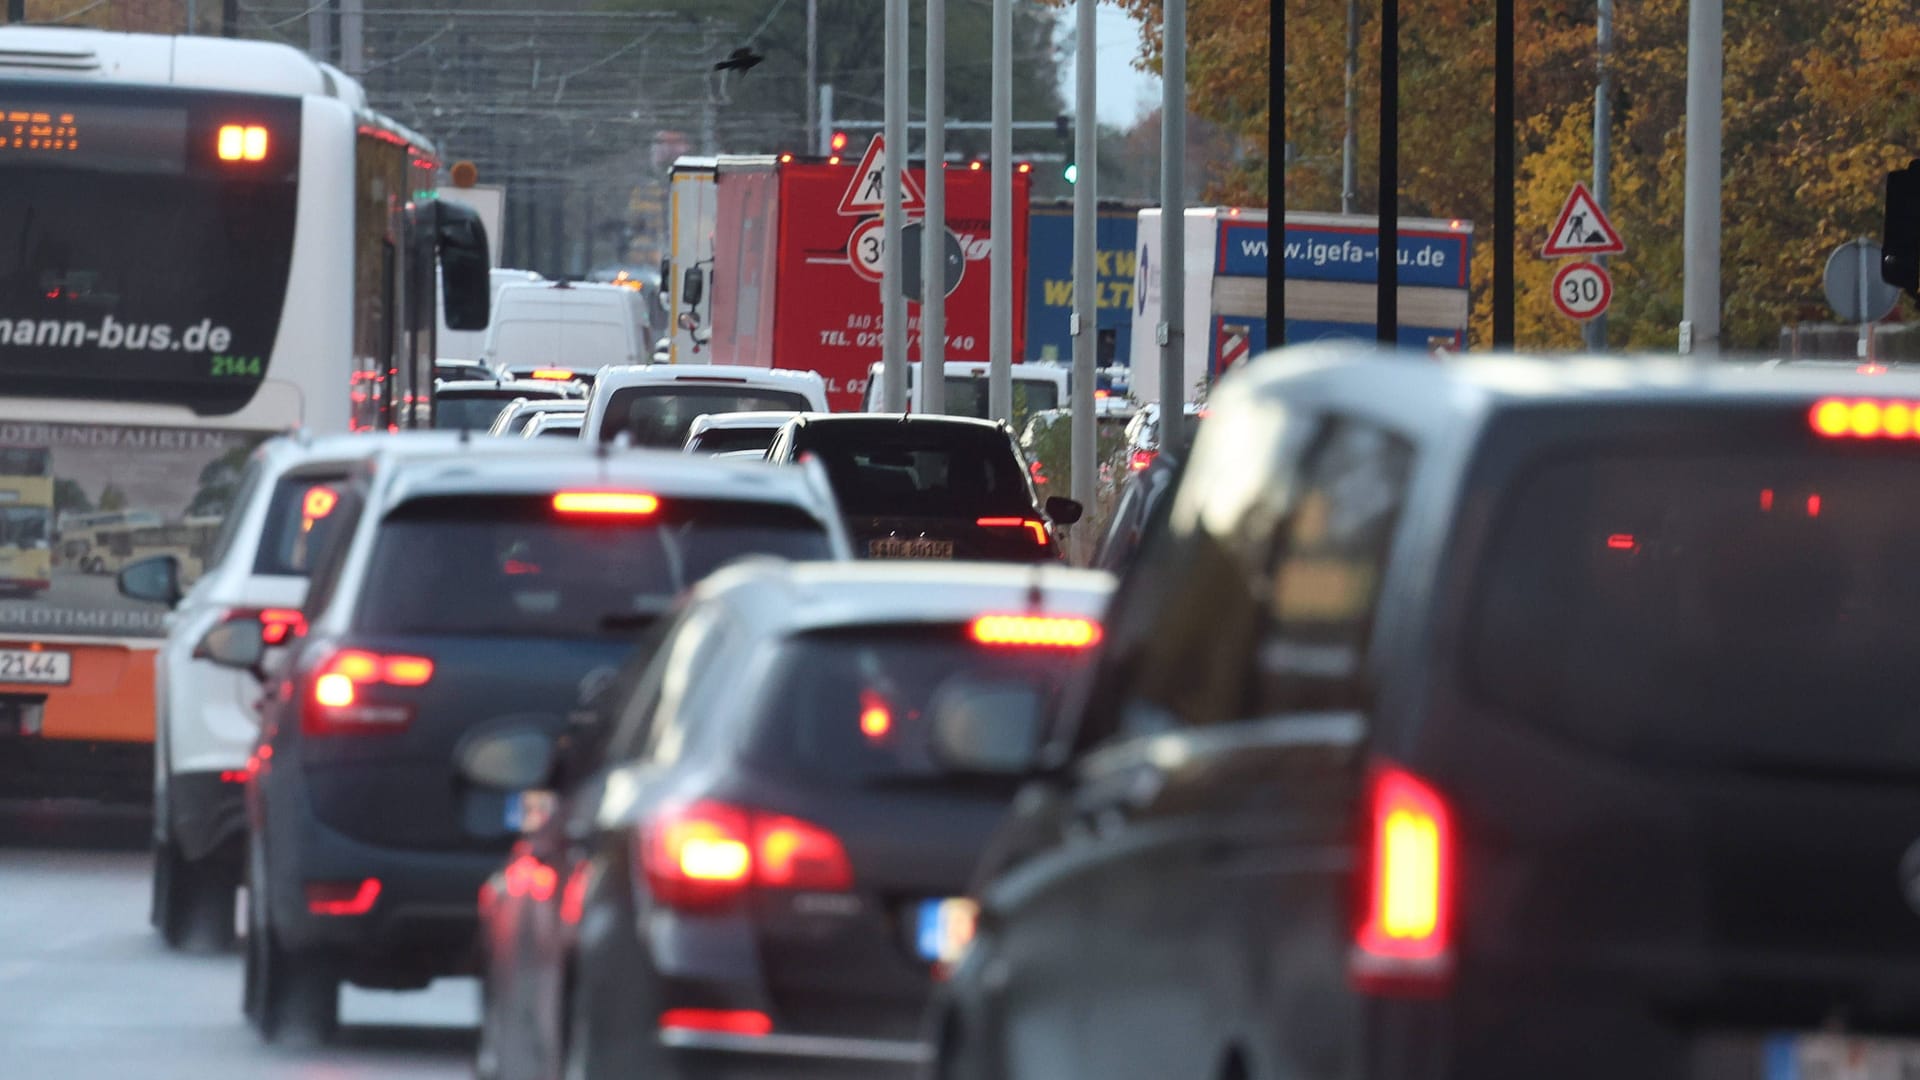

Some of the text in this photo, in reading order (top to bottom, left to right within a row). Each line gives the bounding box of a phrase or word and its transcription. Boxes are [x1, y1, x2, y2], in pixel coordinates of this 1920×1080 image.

[863, 236, 885, 264] 3
[1241, 238, 1445, 267] ww.igefa-u.de
[1070, 250, 1136, 278] KW
[1565, 276, 1598, 304] 30
[847, 313, 872, 329] BAD
[820, 331, 851, 347] TEL.
[211, 355, 262, 377] 2144
[847, 378, 868, 394] 03
[0, 607, 163, 628] OLDTIMERBU
[0, 653, 57, 675] 2144
